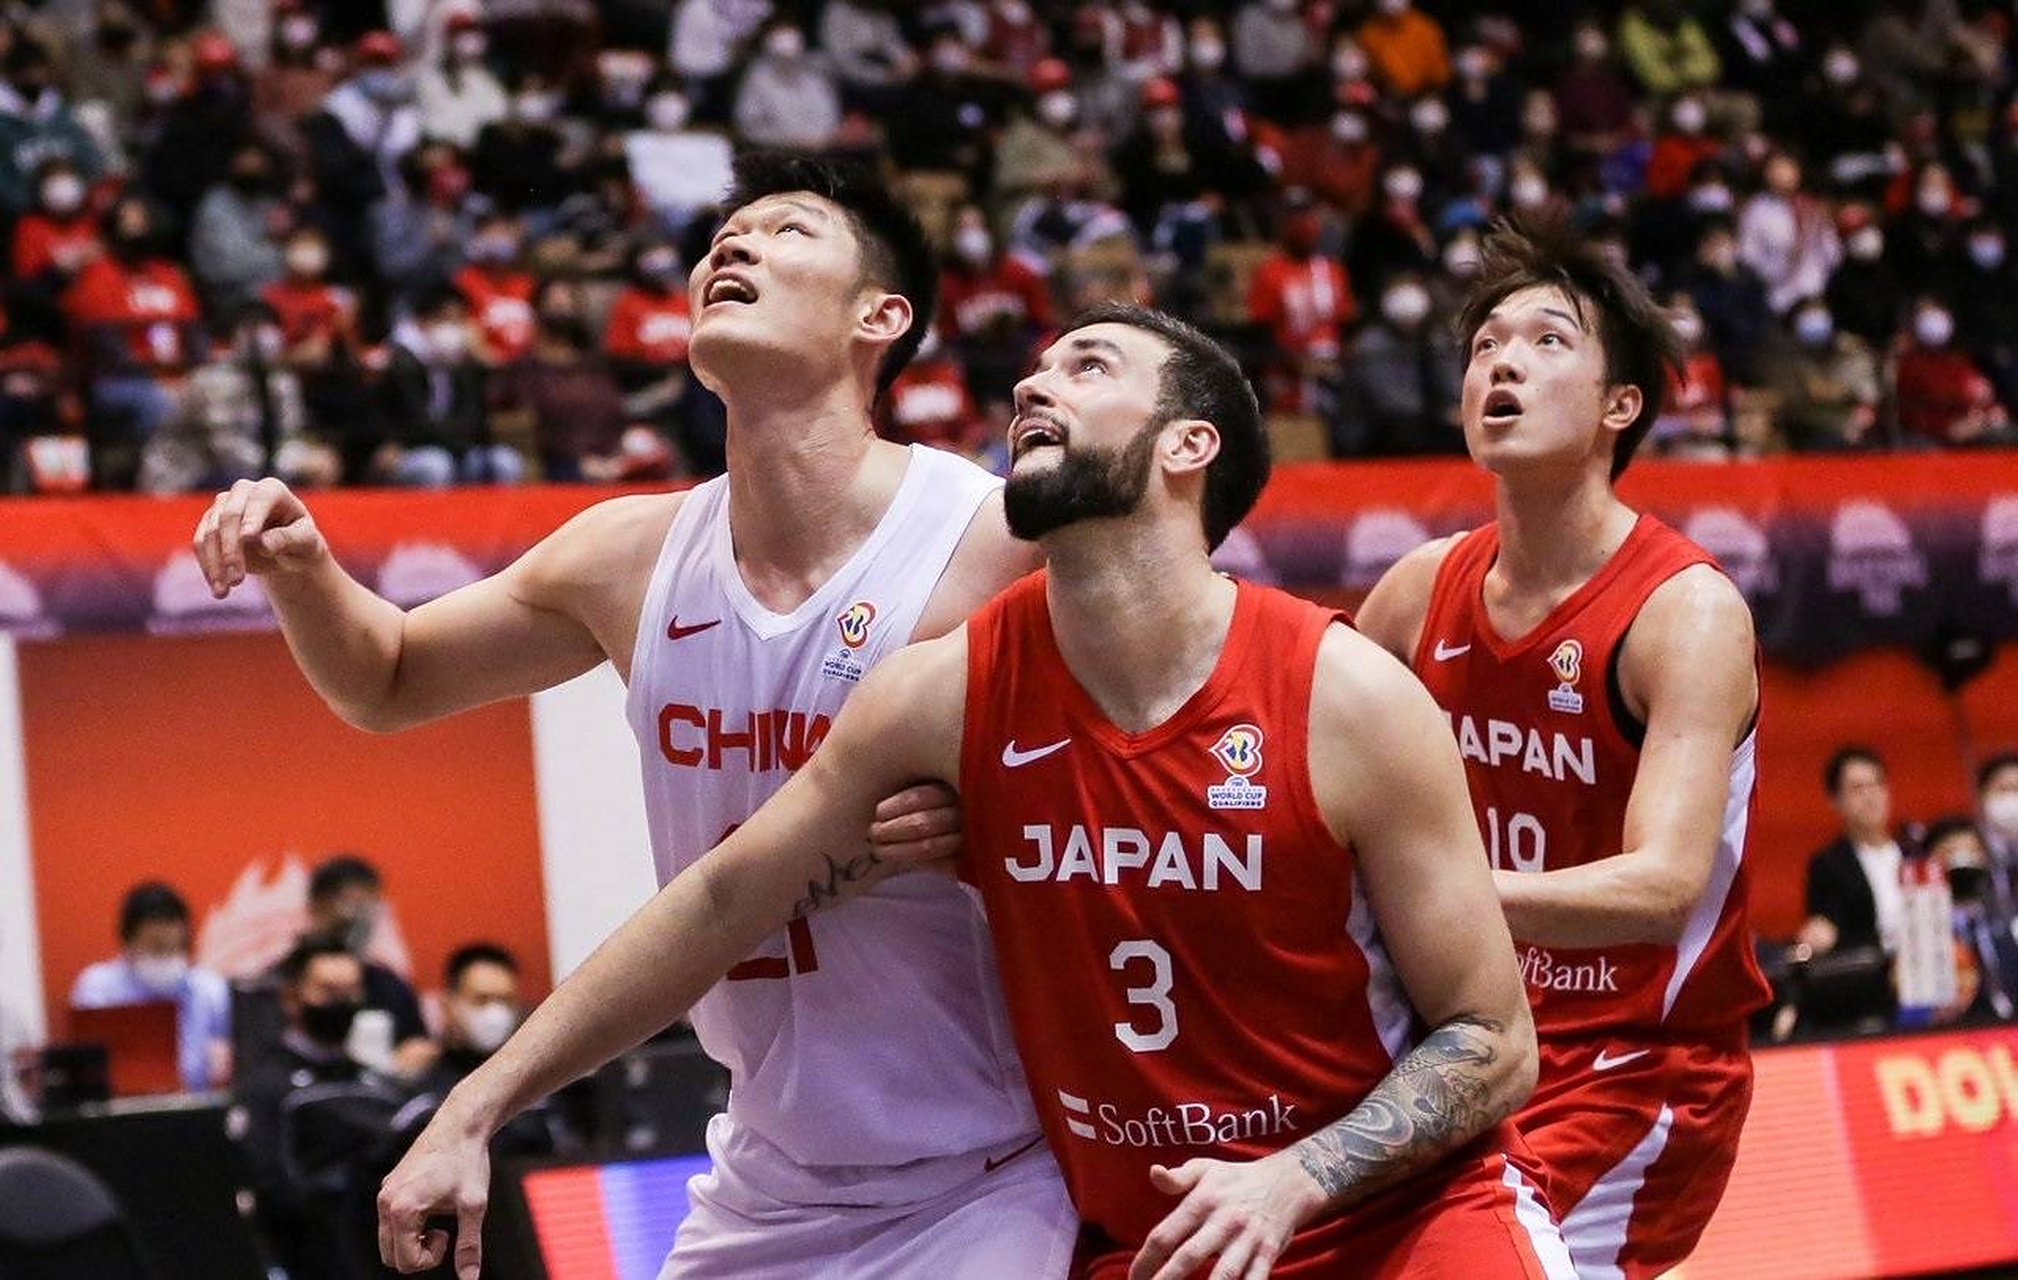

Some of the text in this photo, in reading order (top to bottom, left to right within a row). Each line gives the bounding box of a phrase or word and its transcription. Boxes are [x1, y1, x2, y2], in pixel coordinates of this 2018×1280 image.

[1441, 710, 1597, 785] APAN
[1004, 823, 1263, 891] JAPAN
[1108, 938, 1179, 1053] 3
[1098, 1093, 1299, 1147] SoftBank
